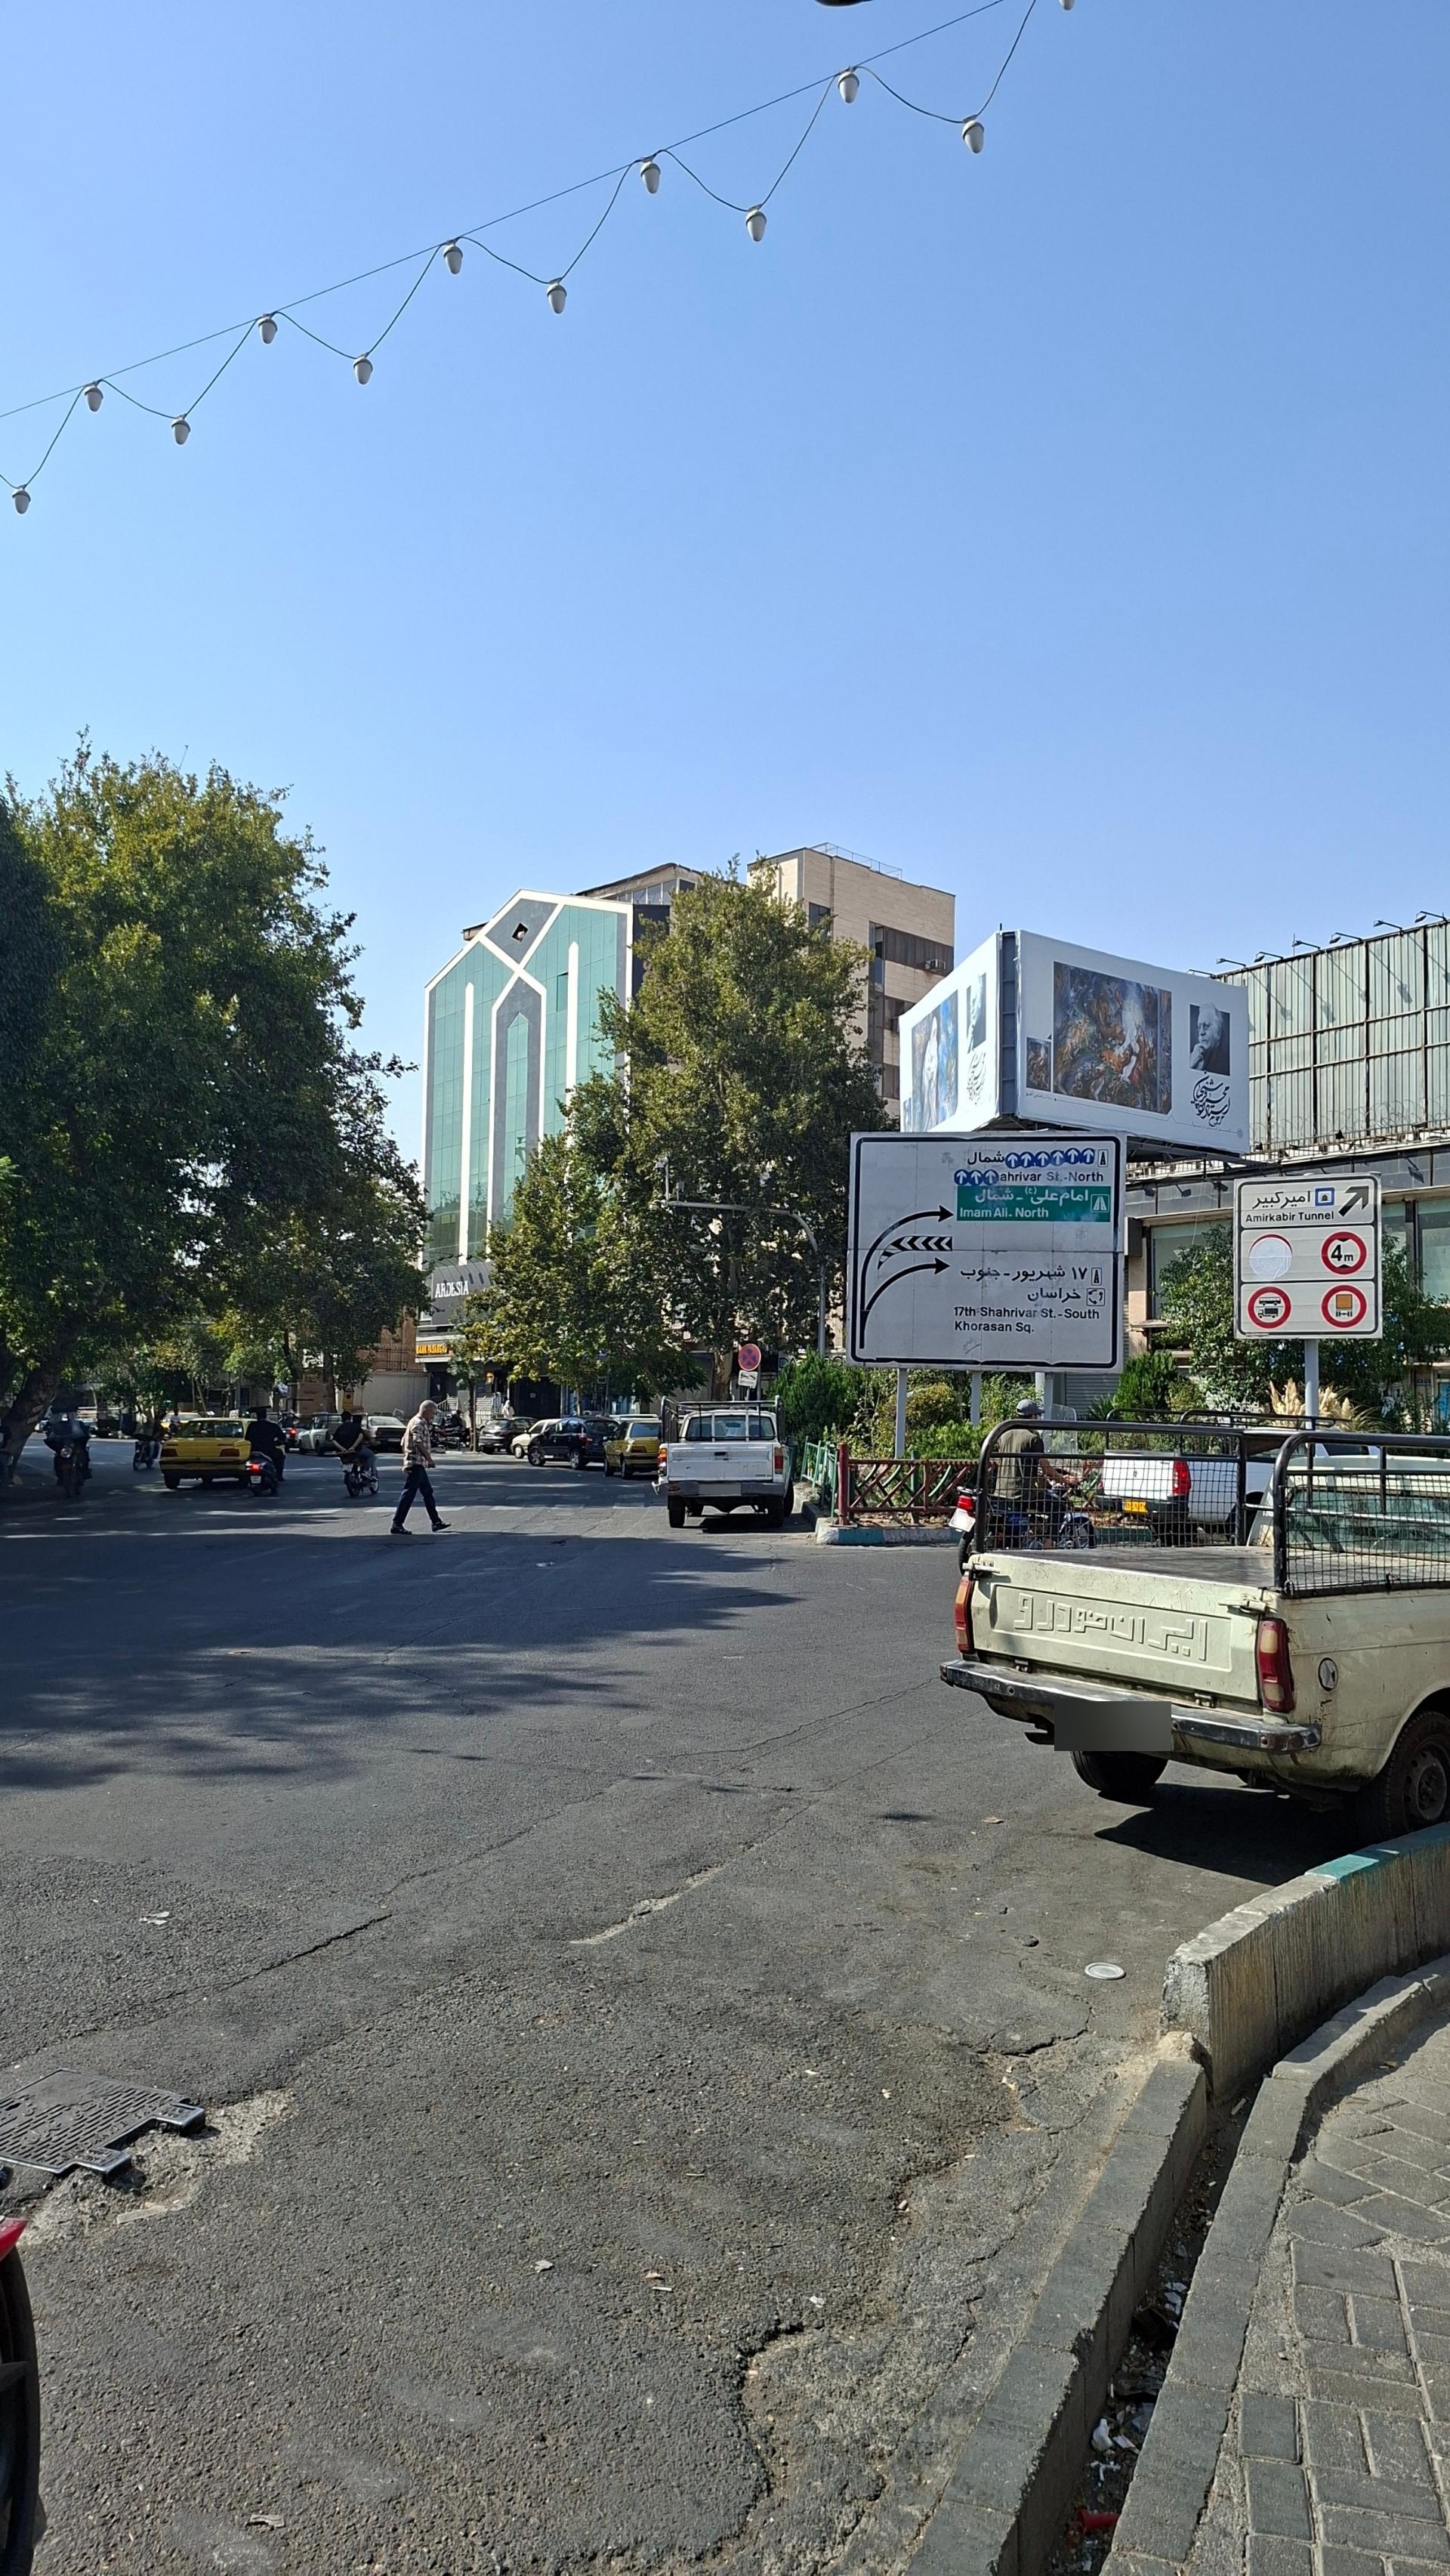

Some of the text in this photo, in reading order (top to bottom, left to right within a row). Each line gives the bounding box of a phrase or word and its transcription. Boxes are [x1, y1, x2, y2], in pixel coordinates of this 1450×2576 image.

[967, 1151, 1005, 1165] شمال
[1000, 1172, 1041, 1181] ahrivar
[975, 1188, 1013, 1203] شمال
[960, 1207, 992, 1218] Imam
[1015, 1207, 1049, 1218] North
[1245, 1210, 1334, 1222] Amirkabir Tunnel
[1072, 1267, 1088, 1280] ۱۷
[435, 1280, 469, 1299] ARDESIA
[1028, 1288, 1081, 1303] خراسان
[980, 1306, 1038, 1318] Shahrivar
[955, 1320, 1035, 1334] Khorasan Sq.
